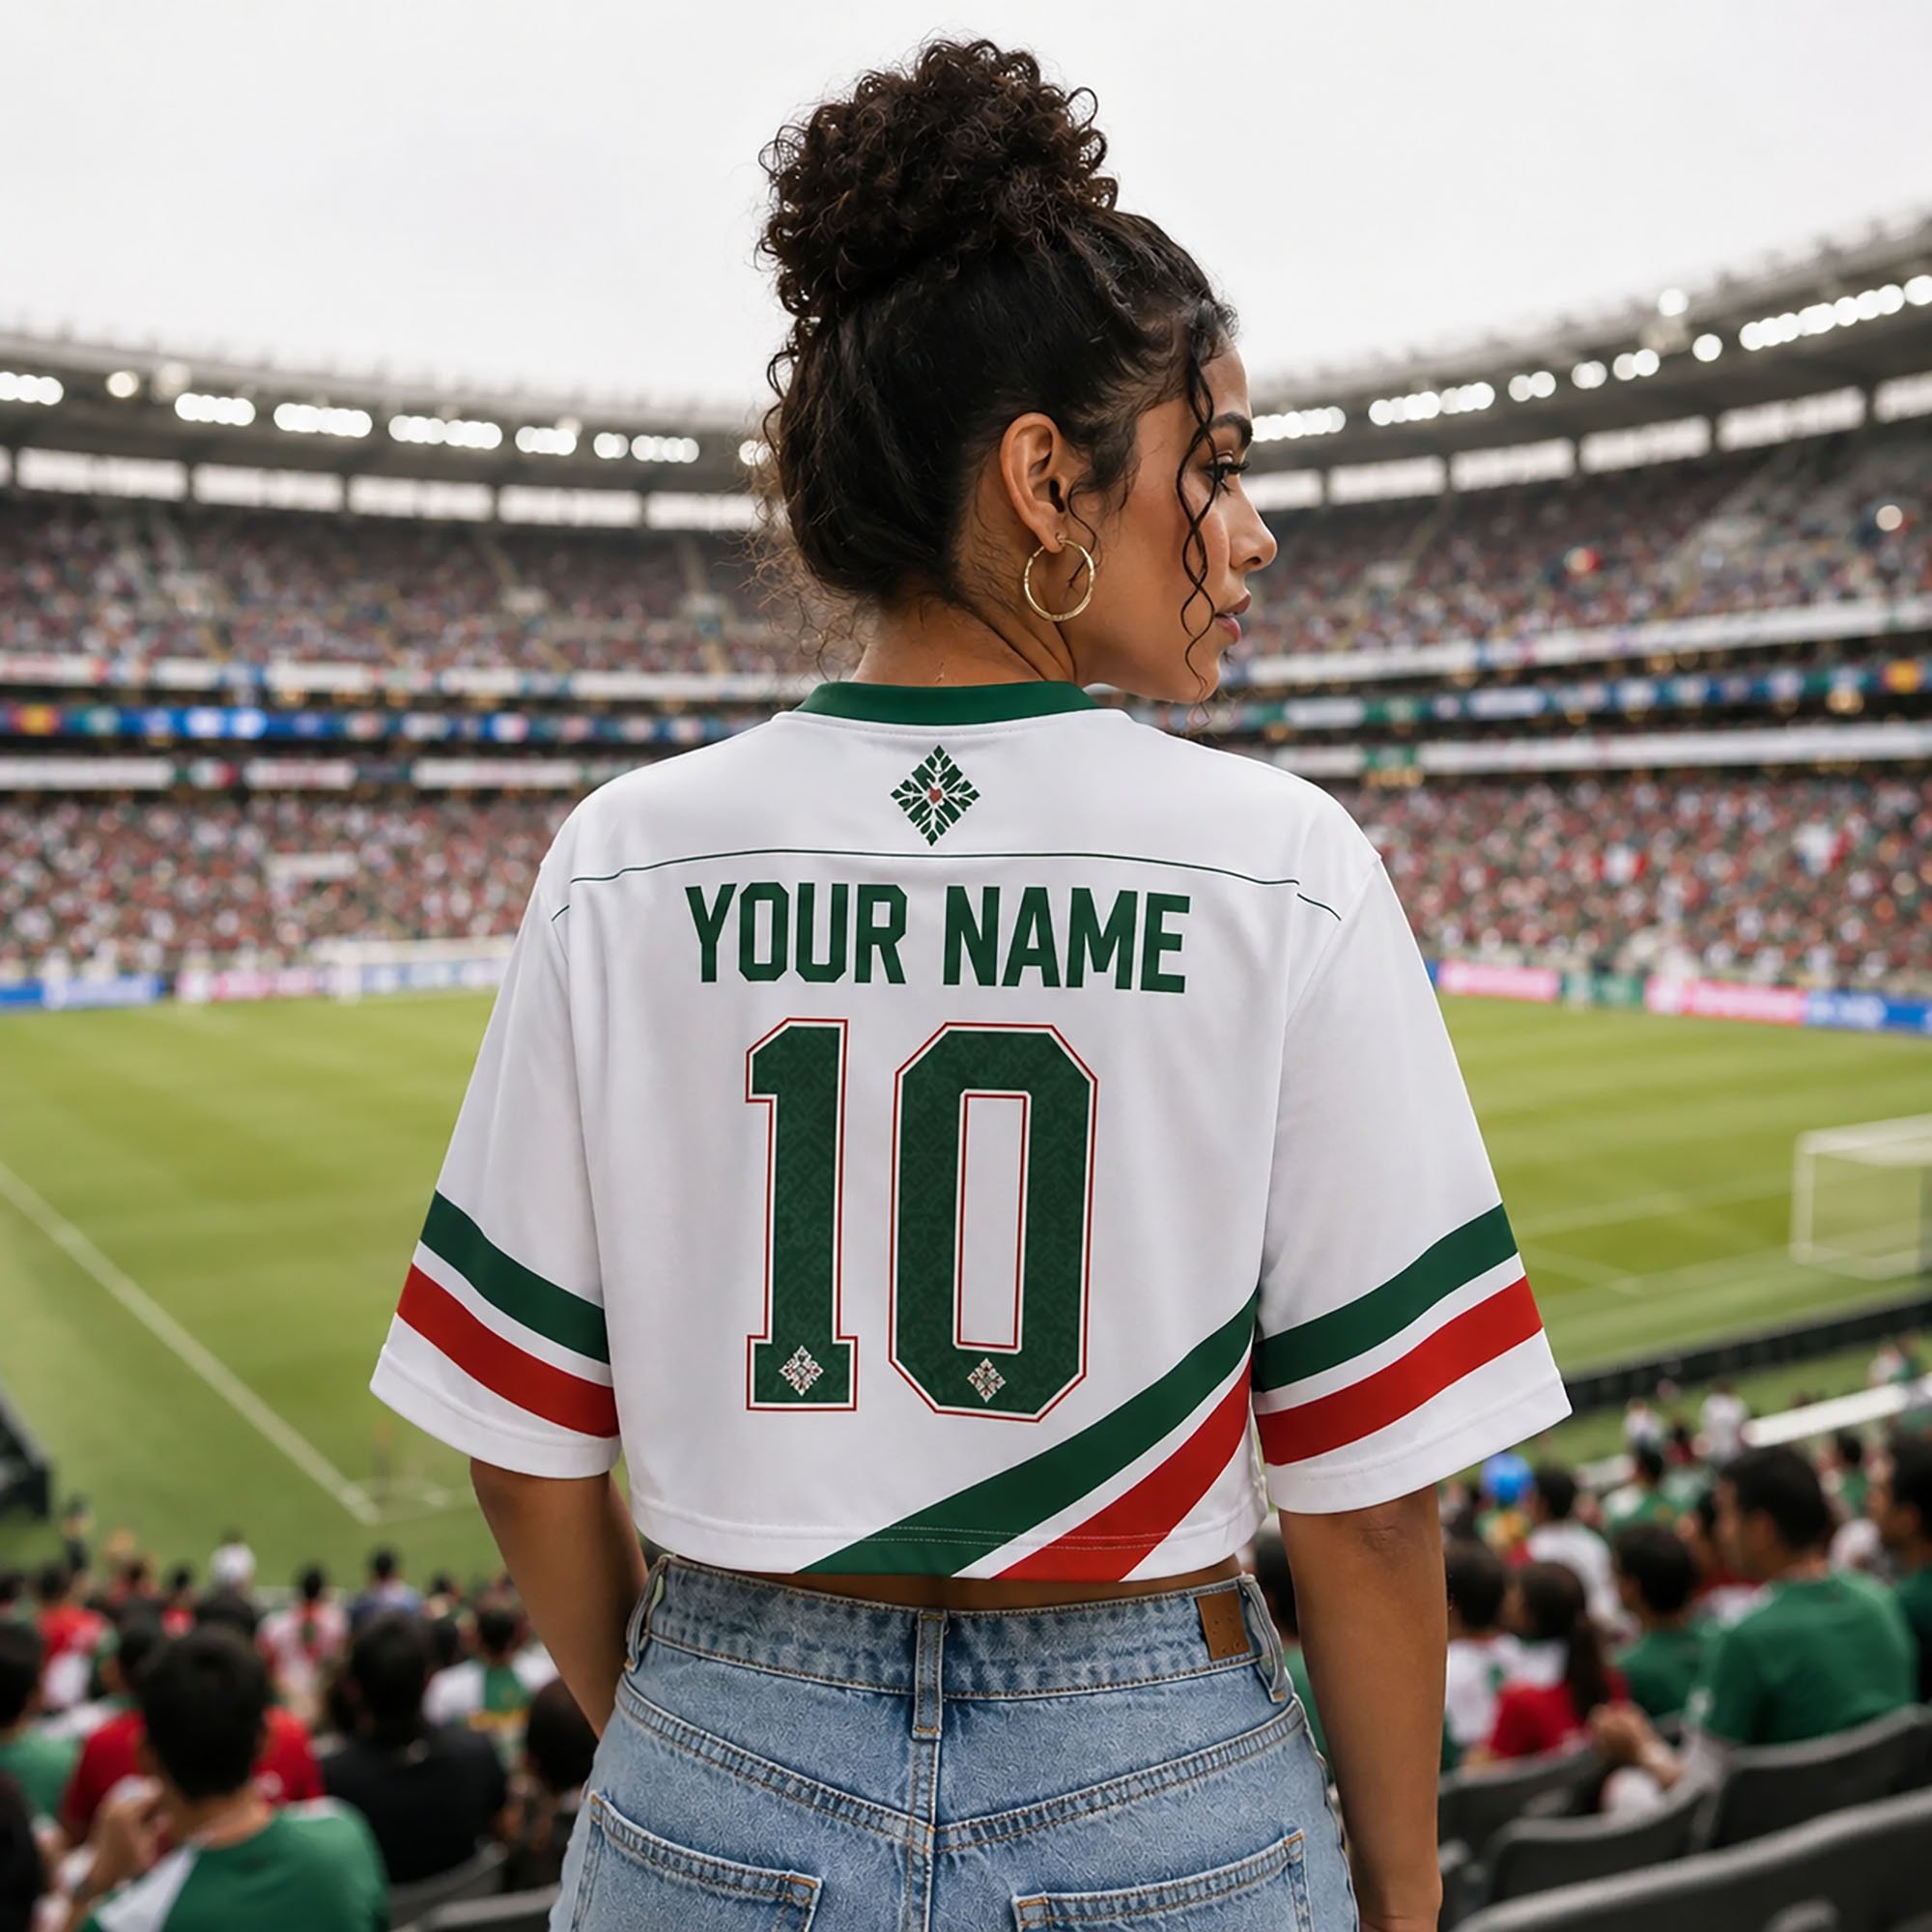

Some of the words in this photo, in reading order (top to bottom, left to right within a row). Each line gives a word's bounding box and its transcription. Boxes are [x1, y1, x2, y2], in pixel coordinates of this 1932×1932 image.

[685, 882, 908, 984] YOUR
[943, 886, 1191, 994] NAME
[745, 1017, 1098, 1424] 10
